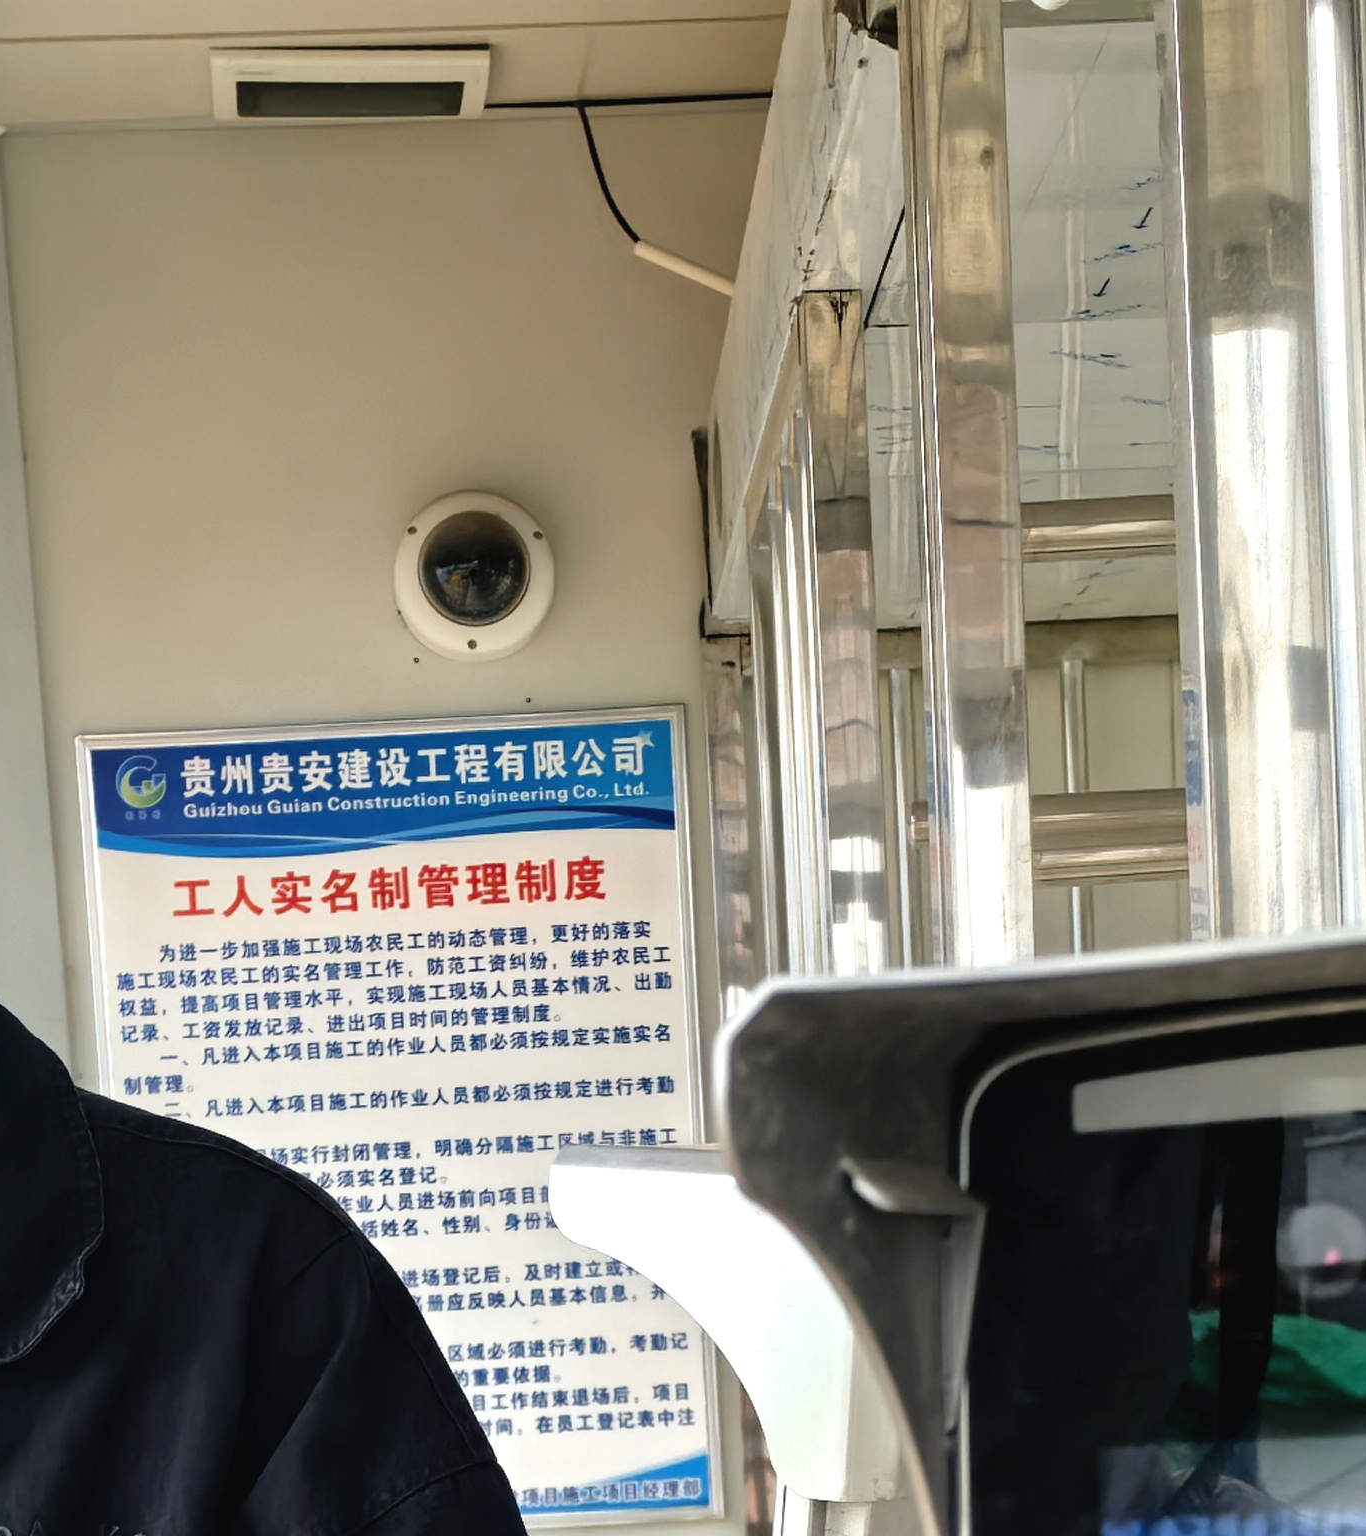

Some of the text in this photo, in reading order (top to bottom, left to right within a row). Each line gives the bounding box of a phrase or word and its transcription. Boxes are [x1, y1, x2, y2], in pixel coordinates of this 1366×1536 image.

[180, 735, 645, 798] 贵州贵安建设工程有限公司
[183, 781, 650, 819] Guizhou Guian Construction Engineering Co., Ltd.
[172, 857, 607, 918] 工人实名制管理制度
[123, 1074, 194, 1096] 制管理。
[257, 1128, 678, 1165] 场实行封闭管理，明确分隔施工区域与非施工
[302, 1166, 448, 1189] 必须实名登记。
[514, 1478, 700, 1505] 项目施工项目经理部
